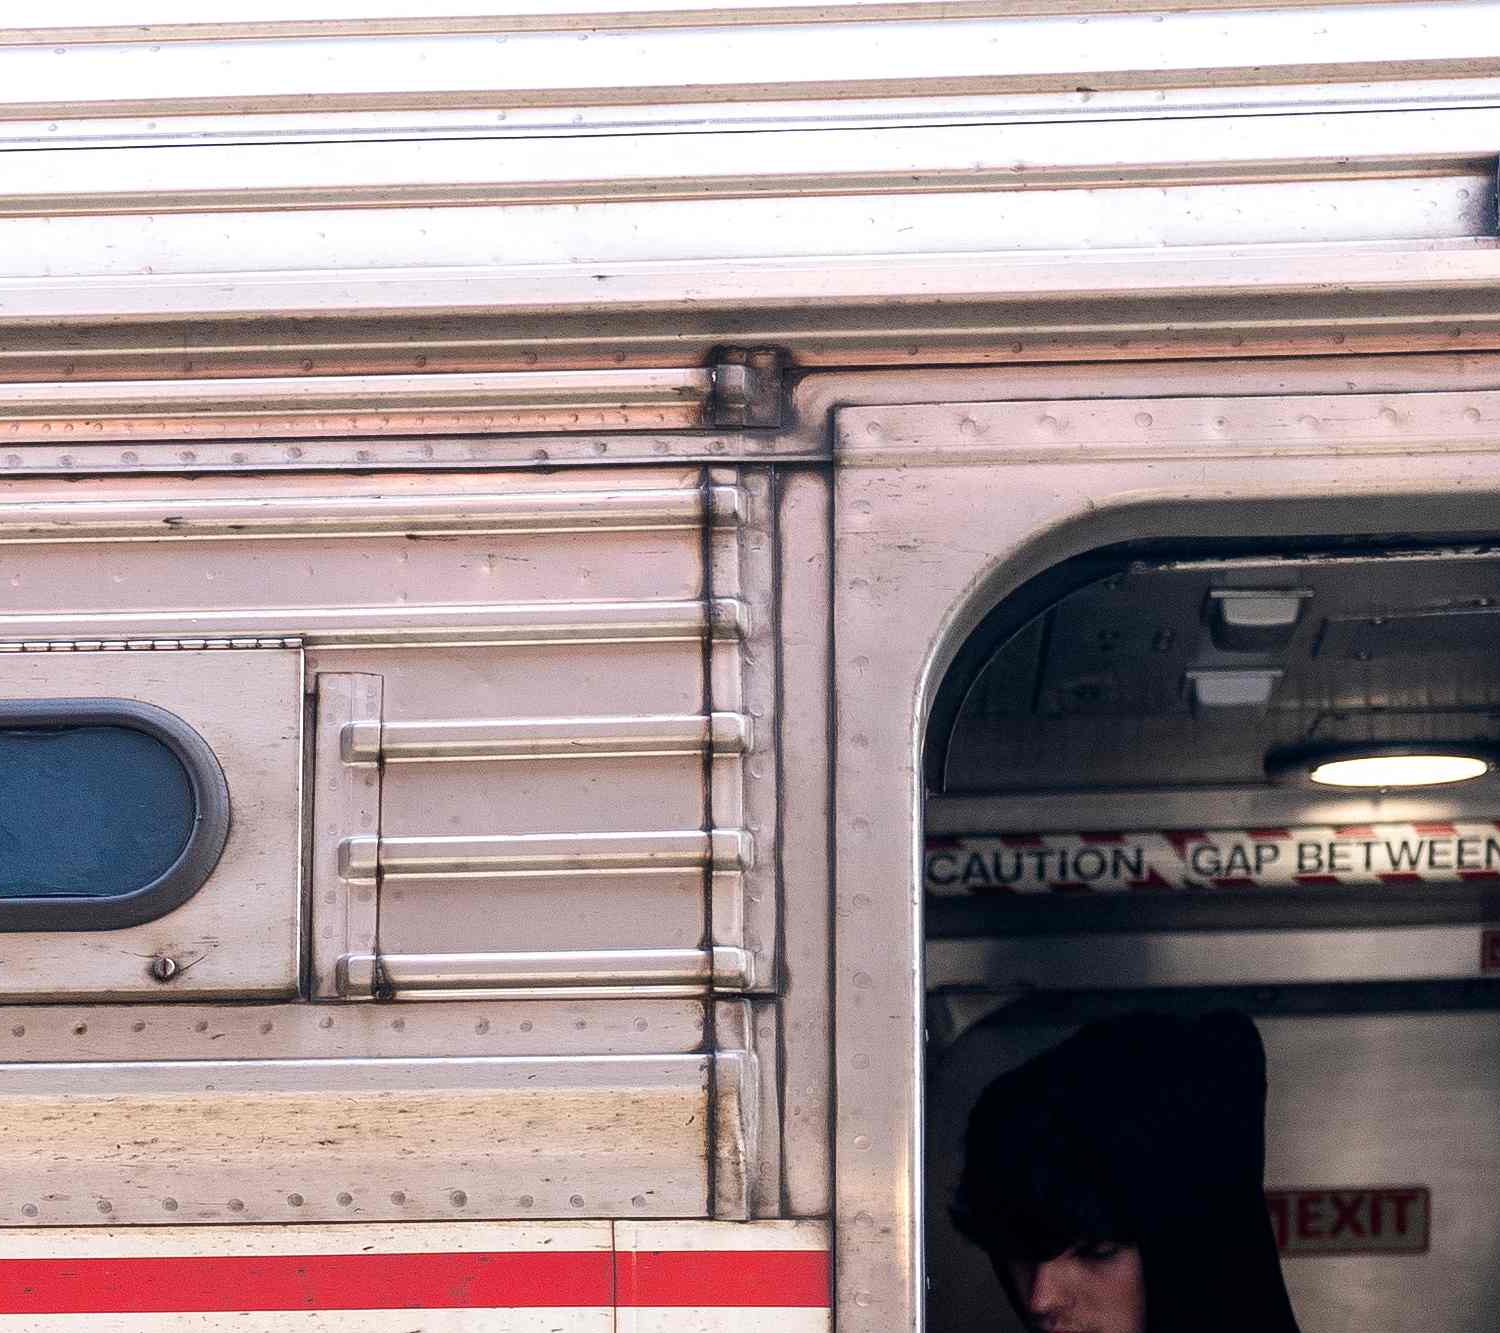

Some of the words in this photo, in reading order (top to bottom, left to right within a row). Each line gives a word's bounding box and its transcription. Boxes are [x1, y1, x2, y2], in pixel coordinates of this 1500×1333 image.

[926, 845, 1146, 886] CAUTION
[1190, 842, 1280, 878] GAP
[1296, 1193, 1418, 1239] EXIT
